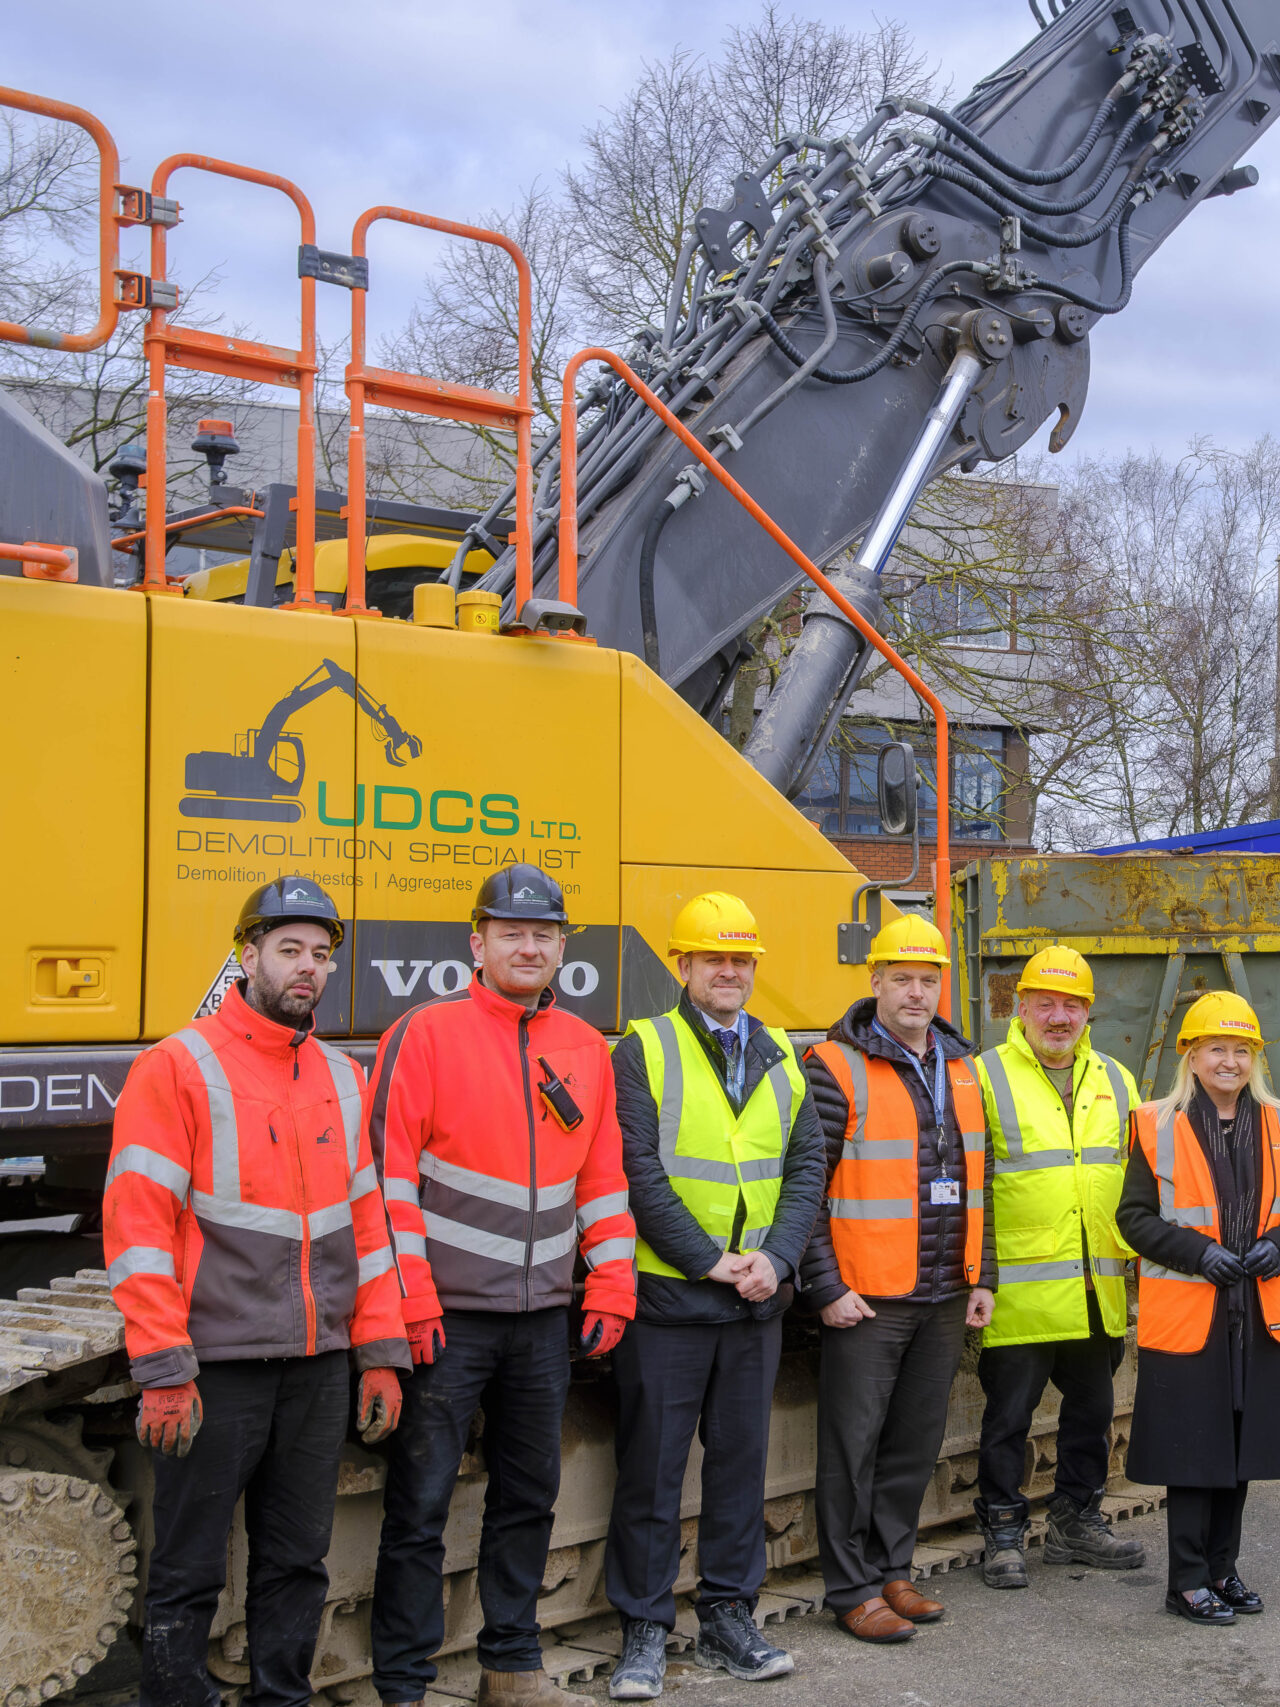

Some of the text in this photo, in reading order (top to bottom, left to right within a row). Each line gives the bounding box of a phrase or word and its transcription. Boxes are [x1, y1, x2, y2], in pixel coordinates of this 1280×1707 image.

[318, 780, 582, 841] UDCS LTD.
[176, 829, 393, 862] DEMOLITION
[176, 864, 267, 883] Demolition
[387, 875, 473, 892] Aggregates
[370, 959, 600, 998] VOO
